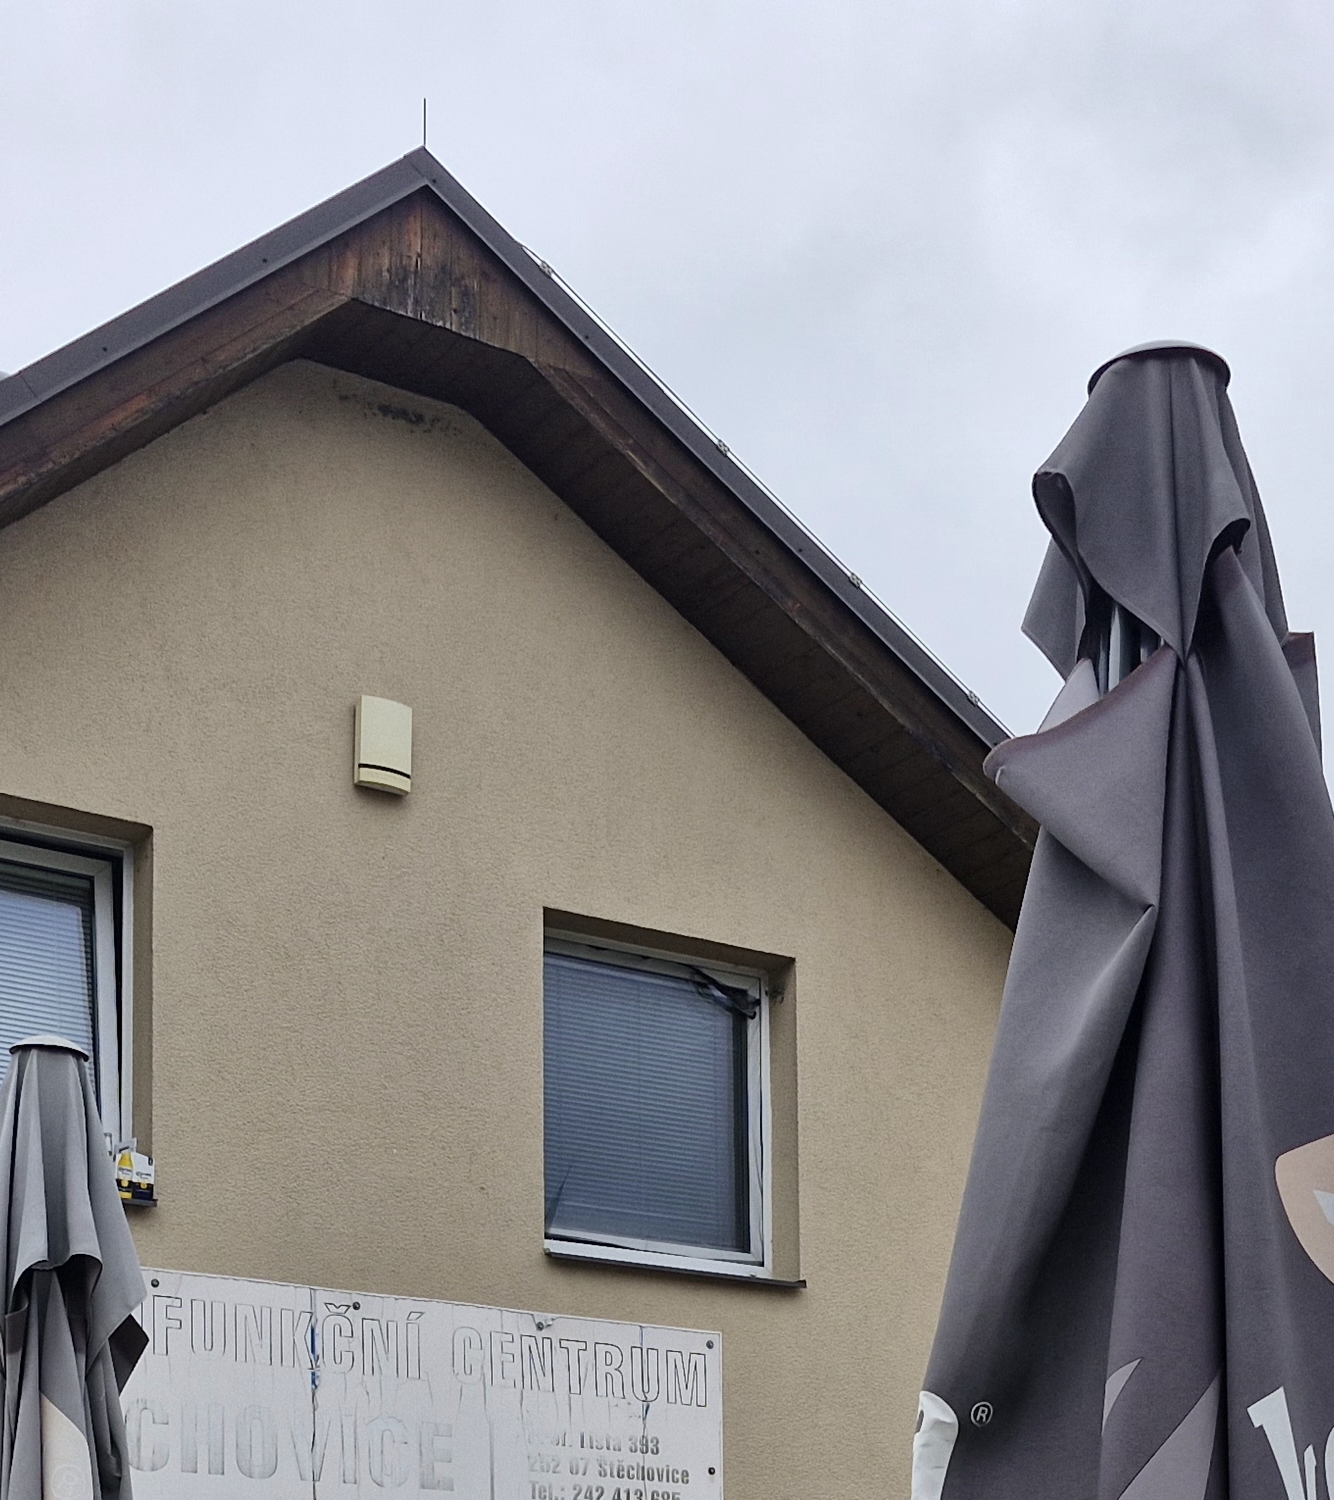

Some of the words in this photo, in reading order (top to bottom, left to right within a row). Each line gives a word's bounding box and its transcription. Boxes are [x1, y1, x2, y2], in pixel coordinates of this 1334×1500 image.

[451, 1326, 708, 1408] CENTRUM
[124, 1396, 455, 1493] CHOVICE
[528, 1453, 562, 1475] 252
[569, 1456, 591, 1477] 07
[597, 1455, 690, 1485] Štěchovice
[628, 1434, 660, 1456] 393
